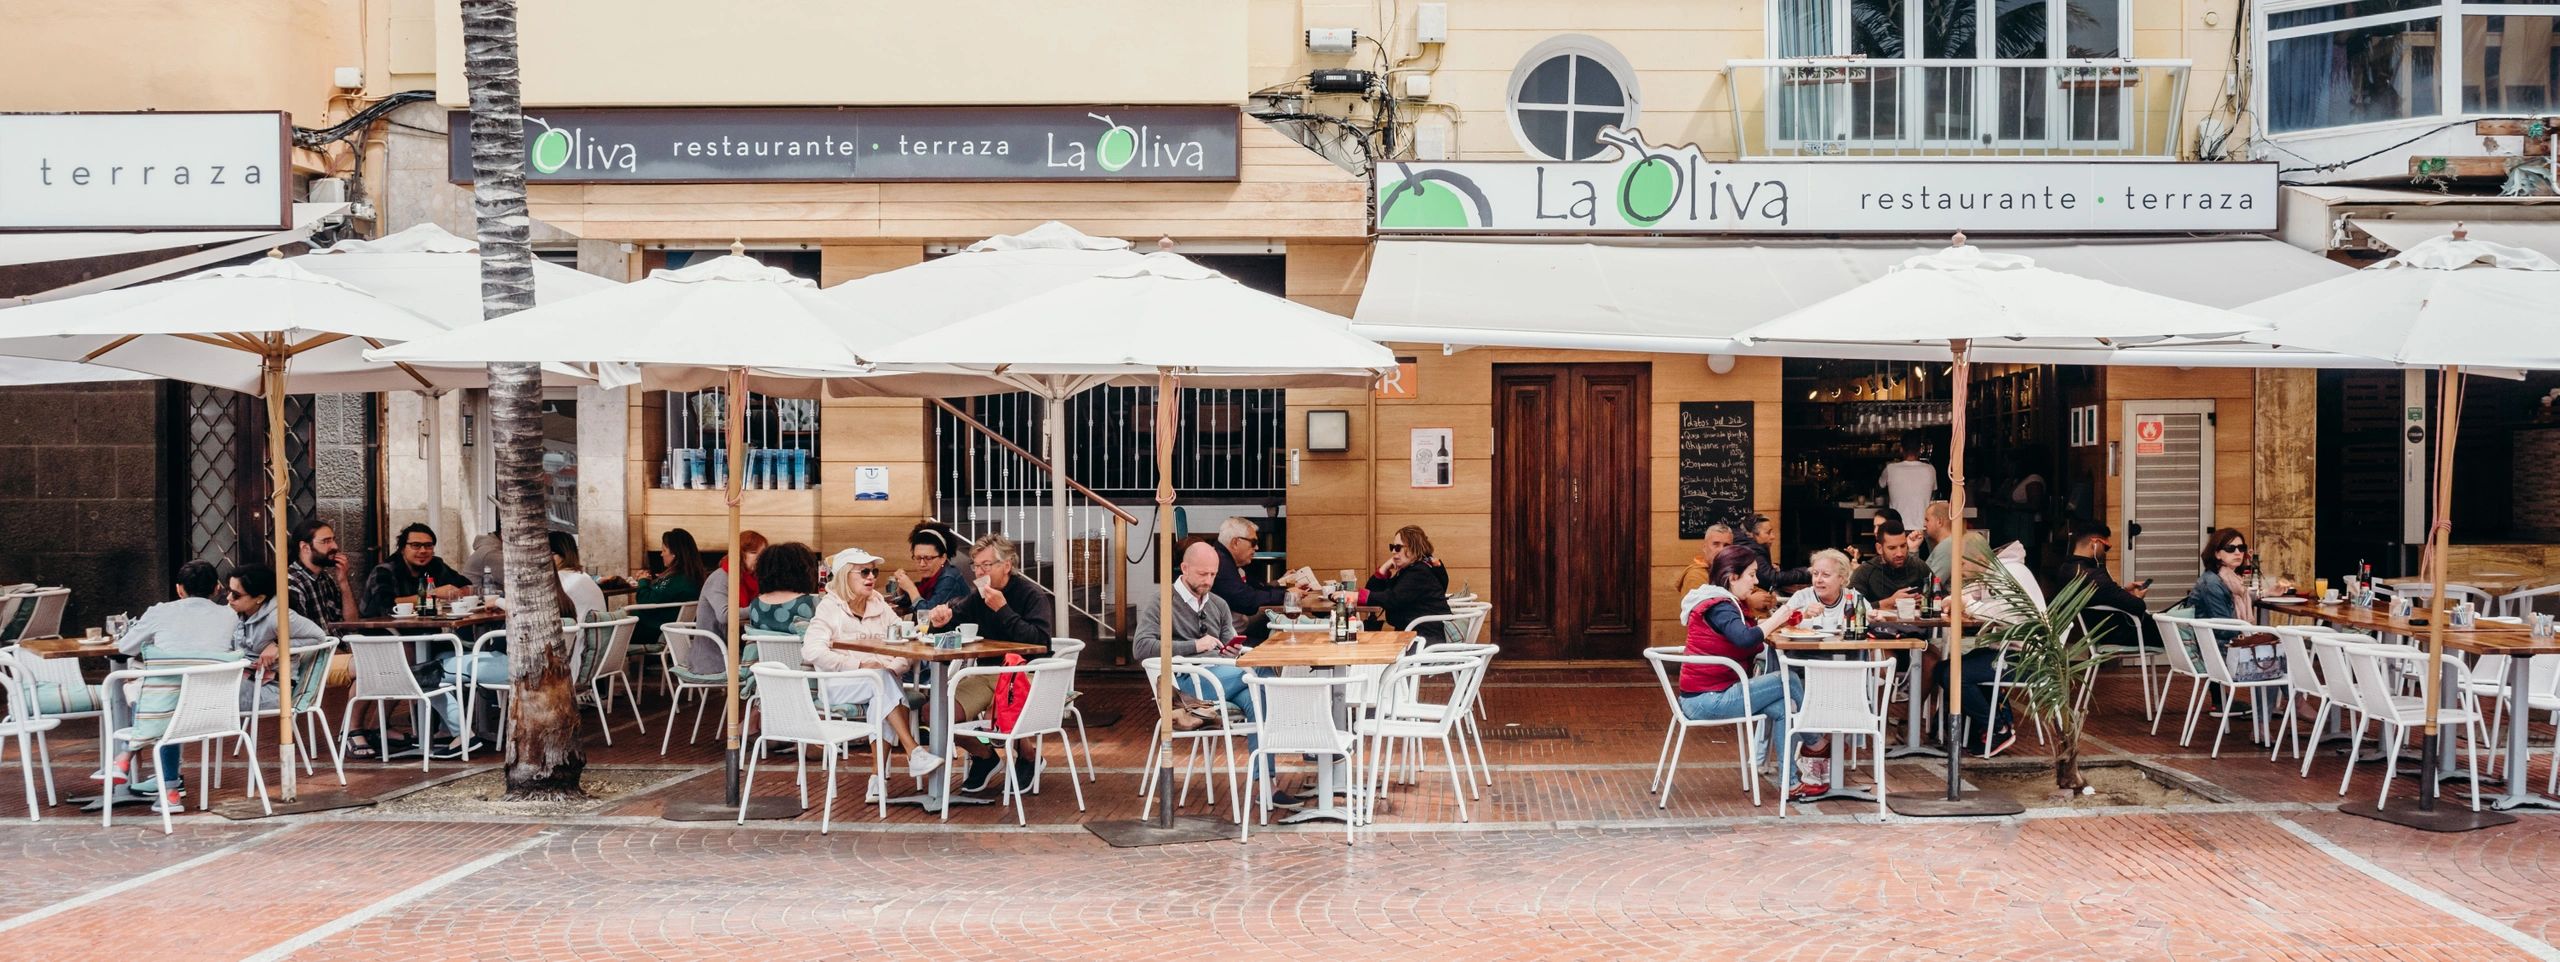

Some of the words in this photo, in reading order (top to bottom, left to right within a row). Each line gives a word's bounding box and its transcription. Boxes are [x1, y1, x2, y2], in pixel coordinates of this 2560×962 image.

[531, 125, 637, 174] Oliva
[673, 135, 854, 157] restaurante
[898, 134, 1010, 157] terraza
[1047, 132, 1086, 172] La
[1098, 122, 1204, 172] Oliva
[40, 158, 262, 186] terraza
[1536, 166, 1597, 227] La
[1616, 150, 1789, 227] Oliva
[1860, 185, 2077, 211] restaurante
[2125, 185, 2255, 211] terraza
